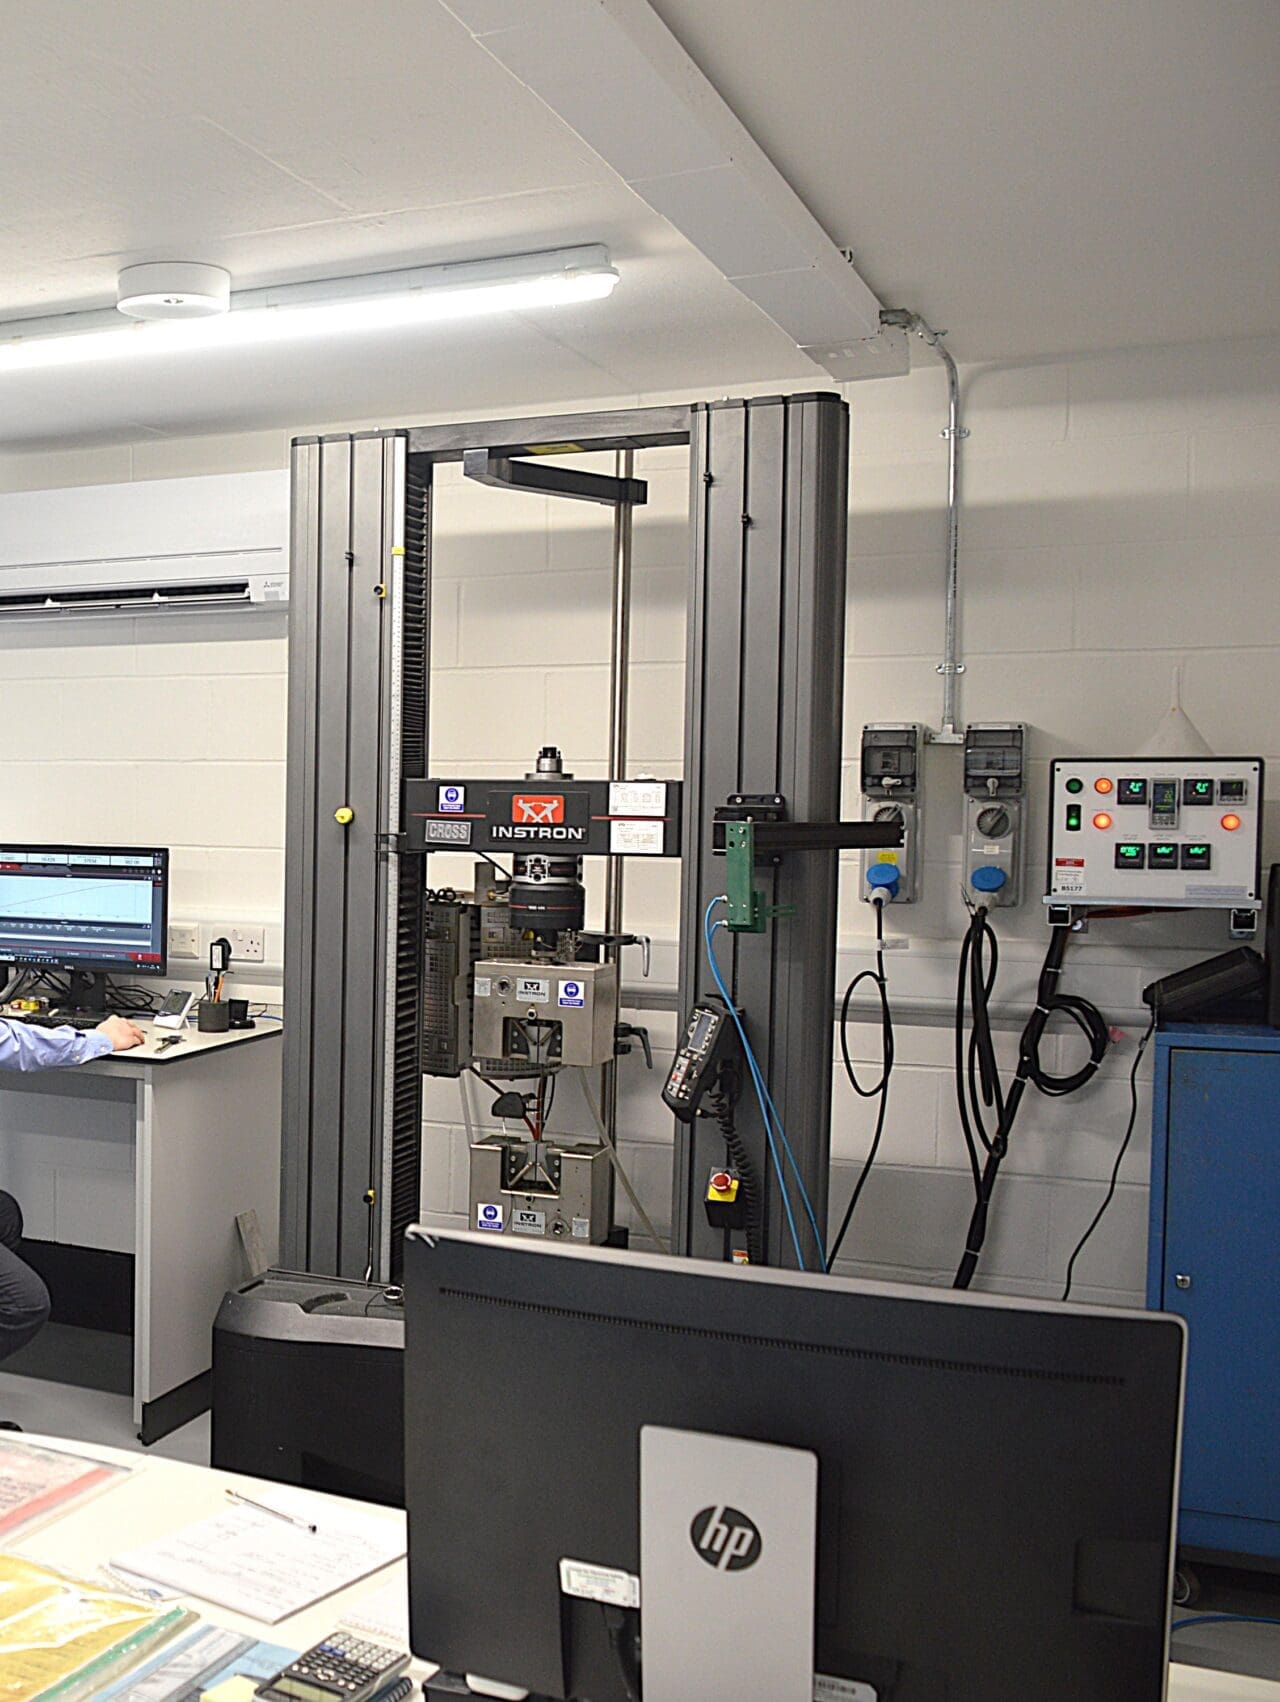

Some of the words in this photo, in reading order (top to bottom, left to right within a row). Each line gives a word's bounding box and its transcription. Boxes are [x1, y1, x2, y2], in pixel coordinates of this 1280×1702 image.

[429, 823, 468, 839] CROSS
[492, 826, 583, 840] INSTRON
[699, 1505, 755, 1571] hp
